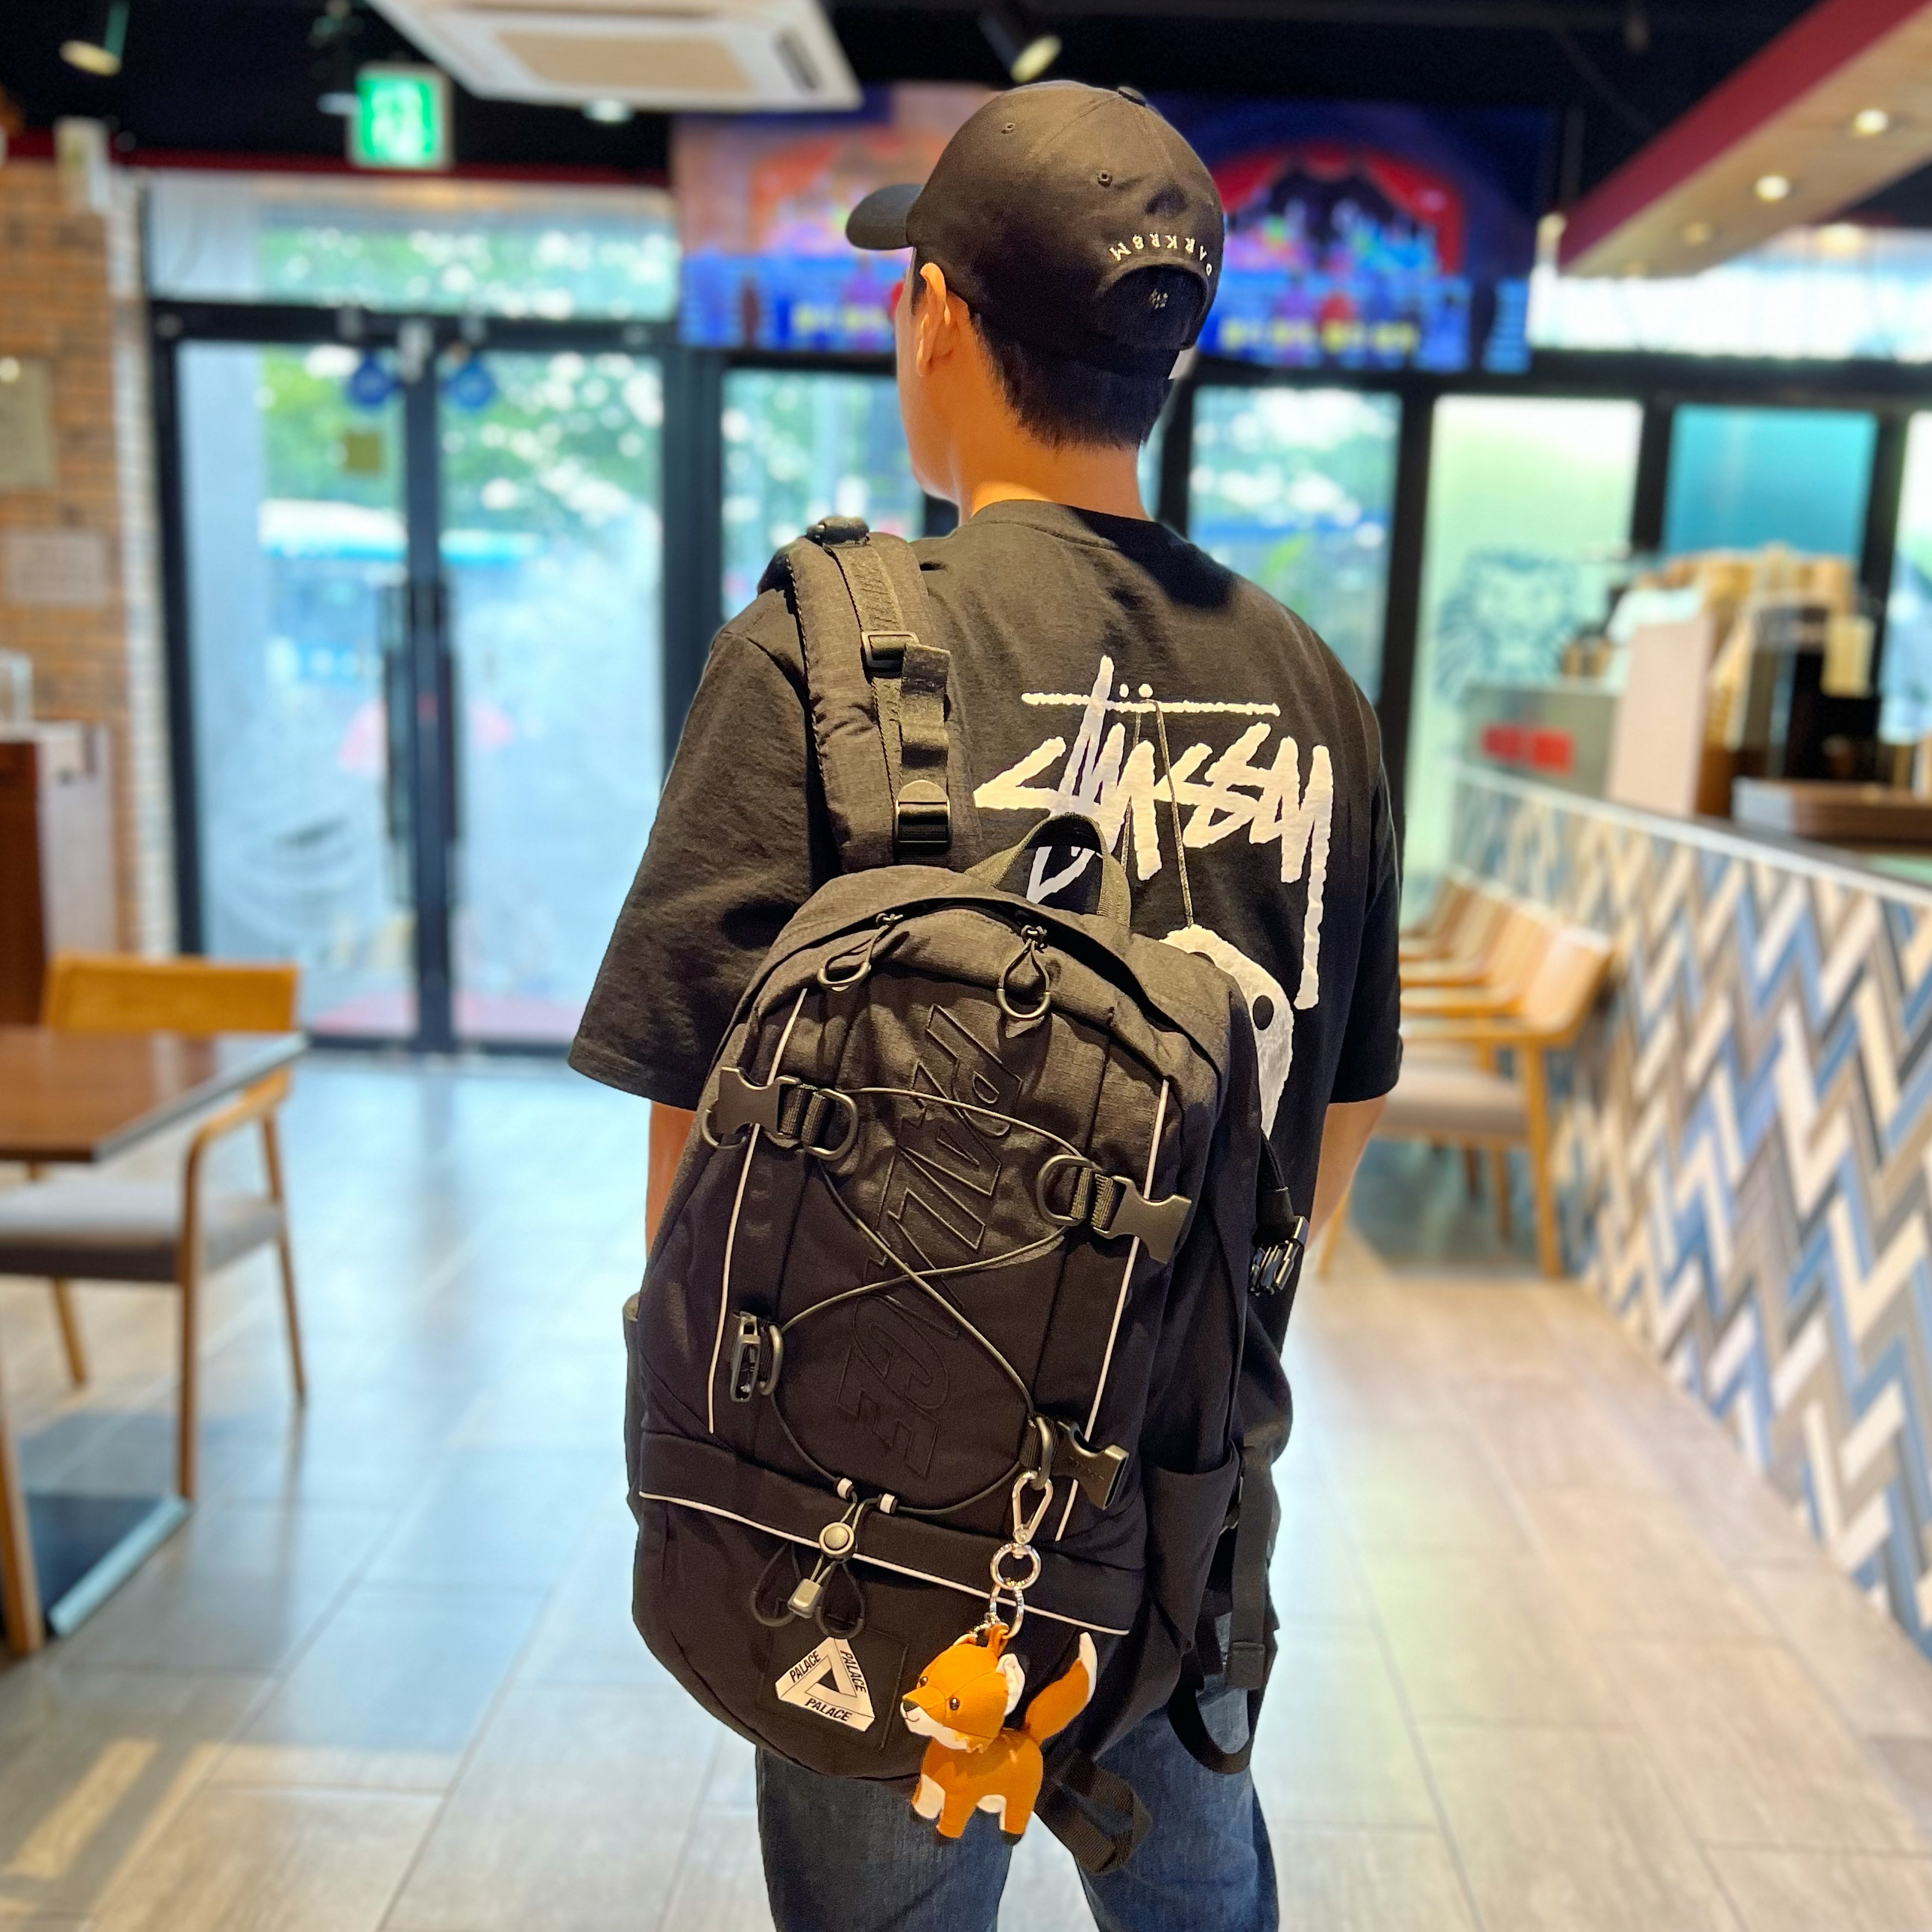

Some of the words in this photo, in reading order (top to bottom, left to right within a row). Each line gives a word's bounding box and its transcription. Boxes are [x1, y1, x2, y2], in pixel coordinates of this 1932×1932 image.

[789, 1650, 822, 1684] PALACE
[840, 1649, 866, 1693] PALACE
[804, 1697, 853, 1722] PALACE
